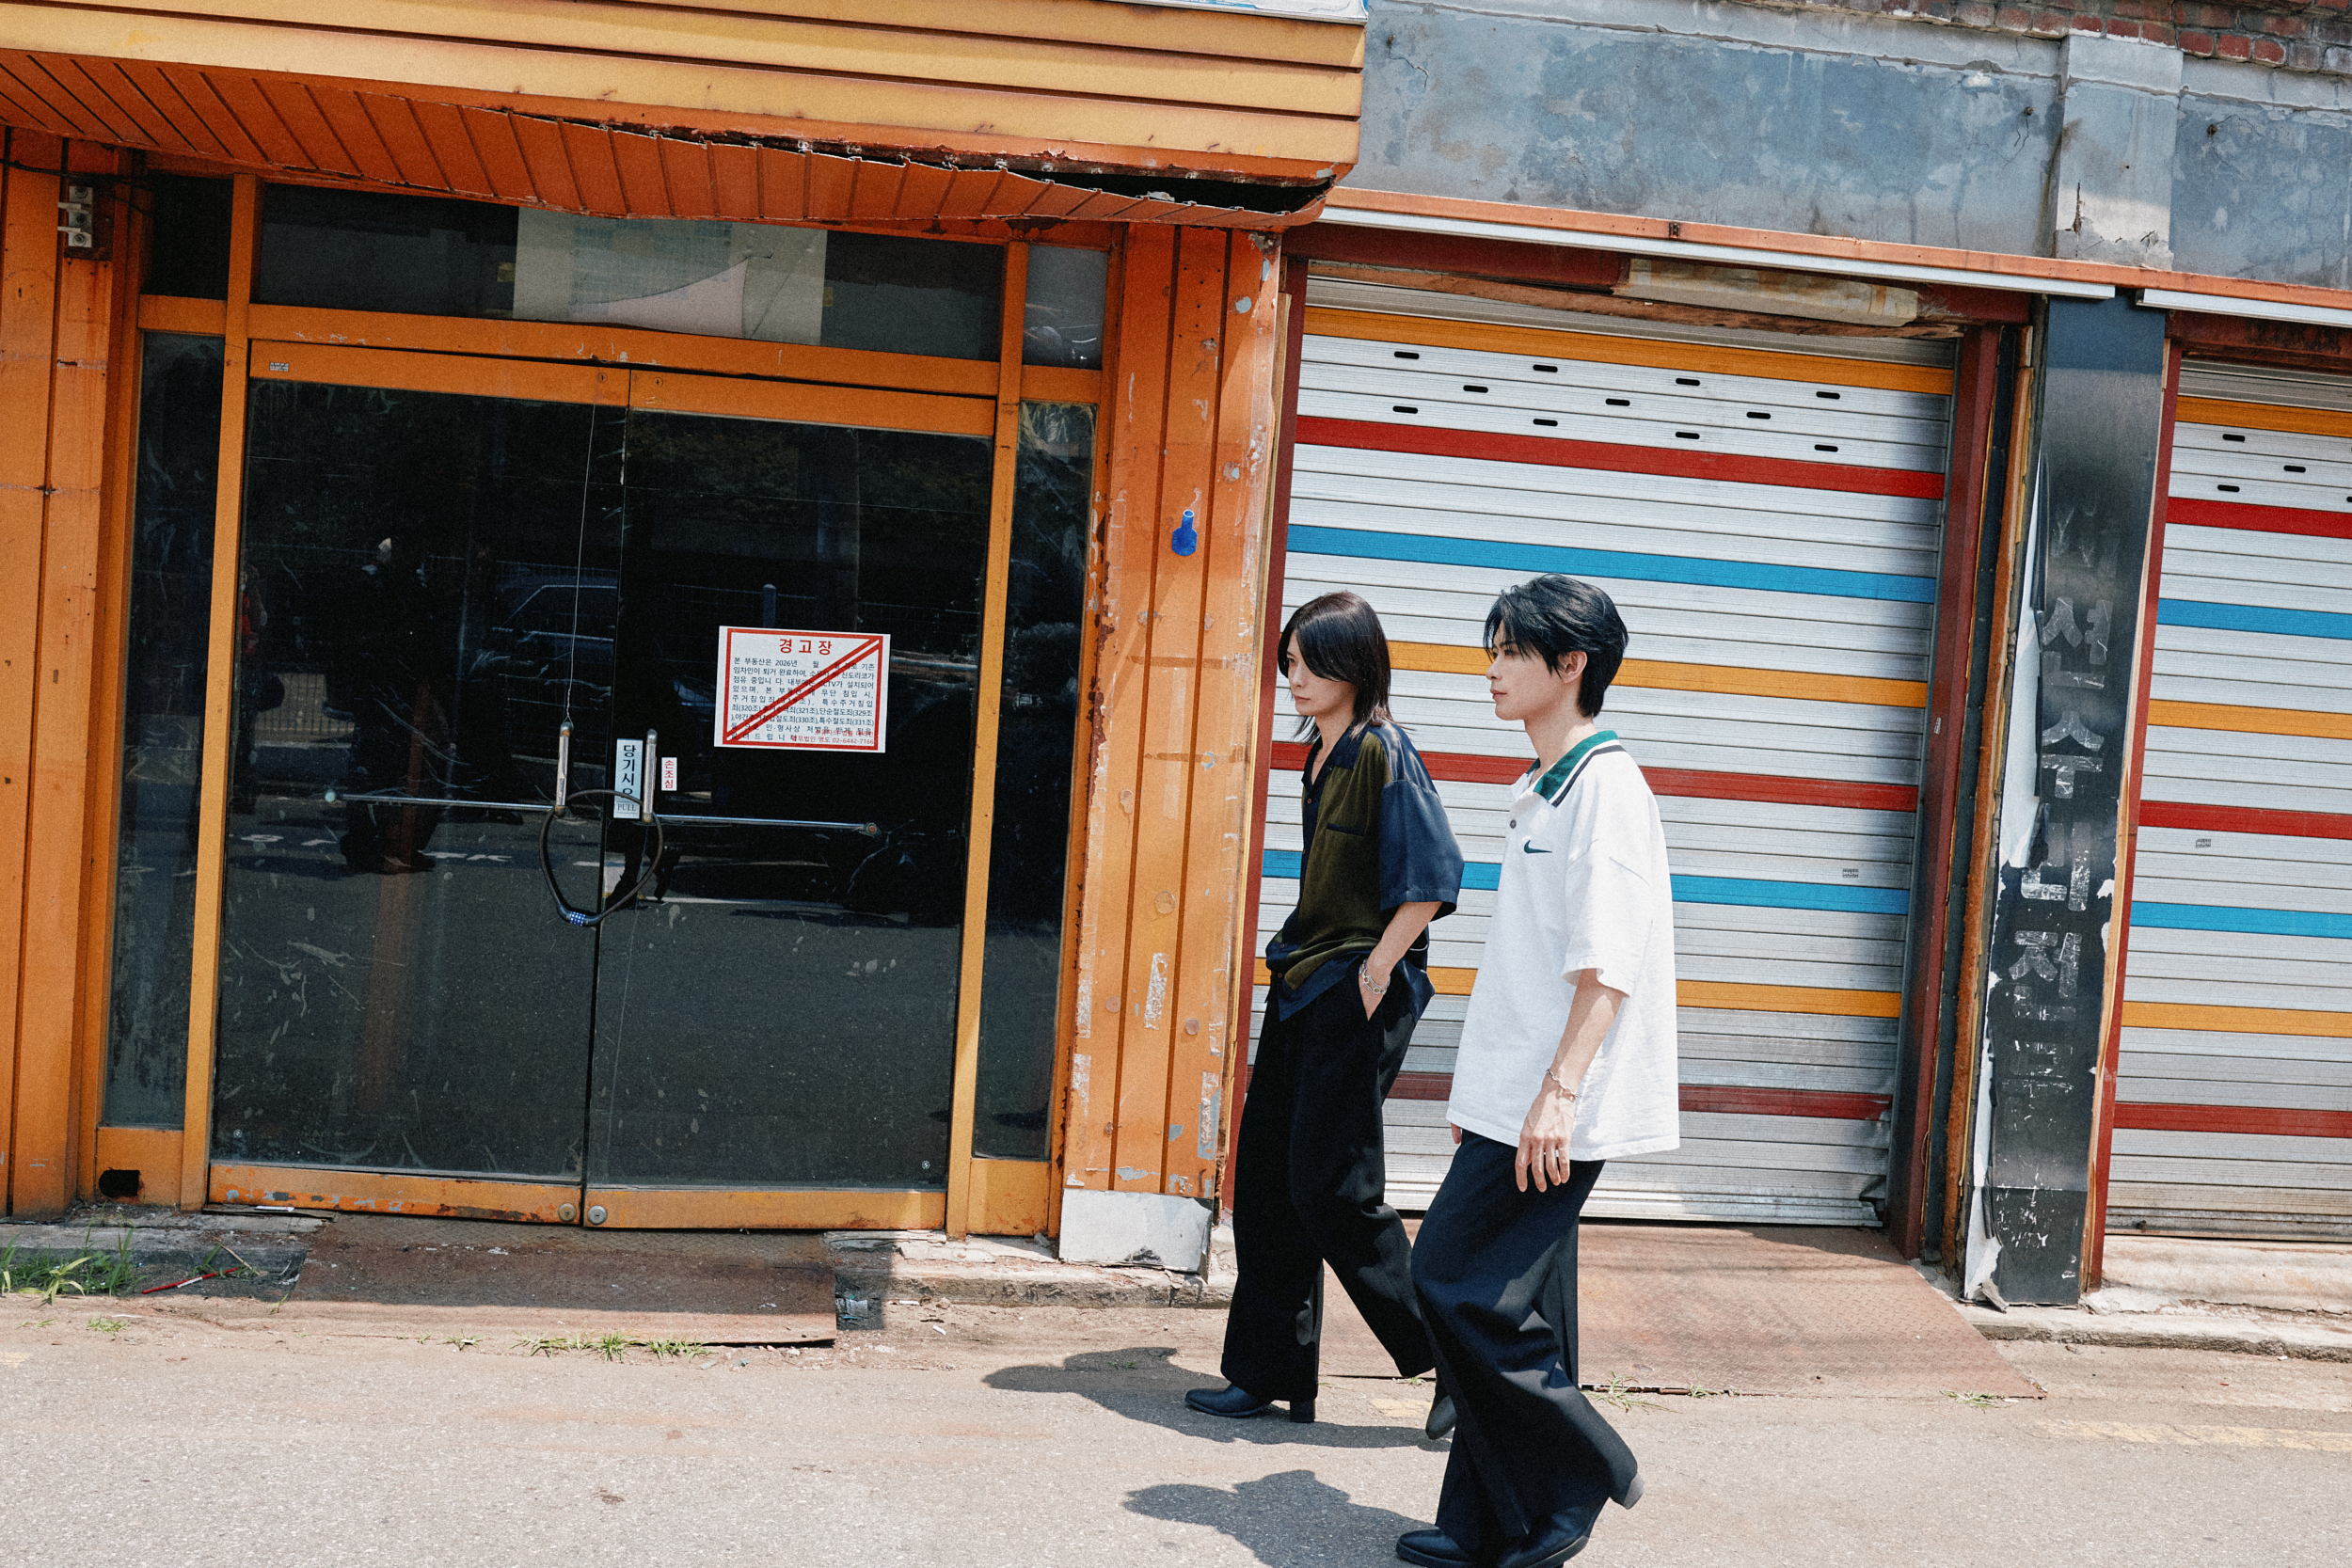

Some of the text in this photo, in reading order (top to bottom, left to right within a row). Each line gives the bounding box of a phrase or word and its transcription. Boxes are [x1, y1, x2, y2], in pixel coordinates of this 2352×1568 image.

[734, 657, 740, 665] 본
[744, 657, 771, 666] 부동산은
[733, 666, 760, 674] 임차인이
[778, 668, 807, 677] 완료하여,
[841, 672, 874, 680] 신도리코가
[733, 675, 747, 684] 점유
[847, 681, 874, 689] 설치되어
[765, 686, 771, 694] 본
[821, 689, 836, 697] 무단
[842, 689, 857, 698] 침입
[664, 759, 675, 789] 손조심
